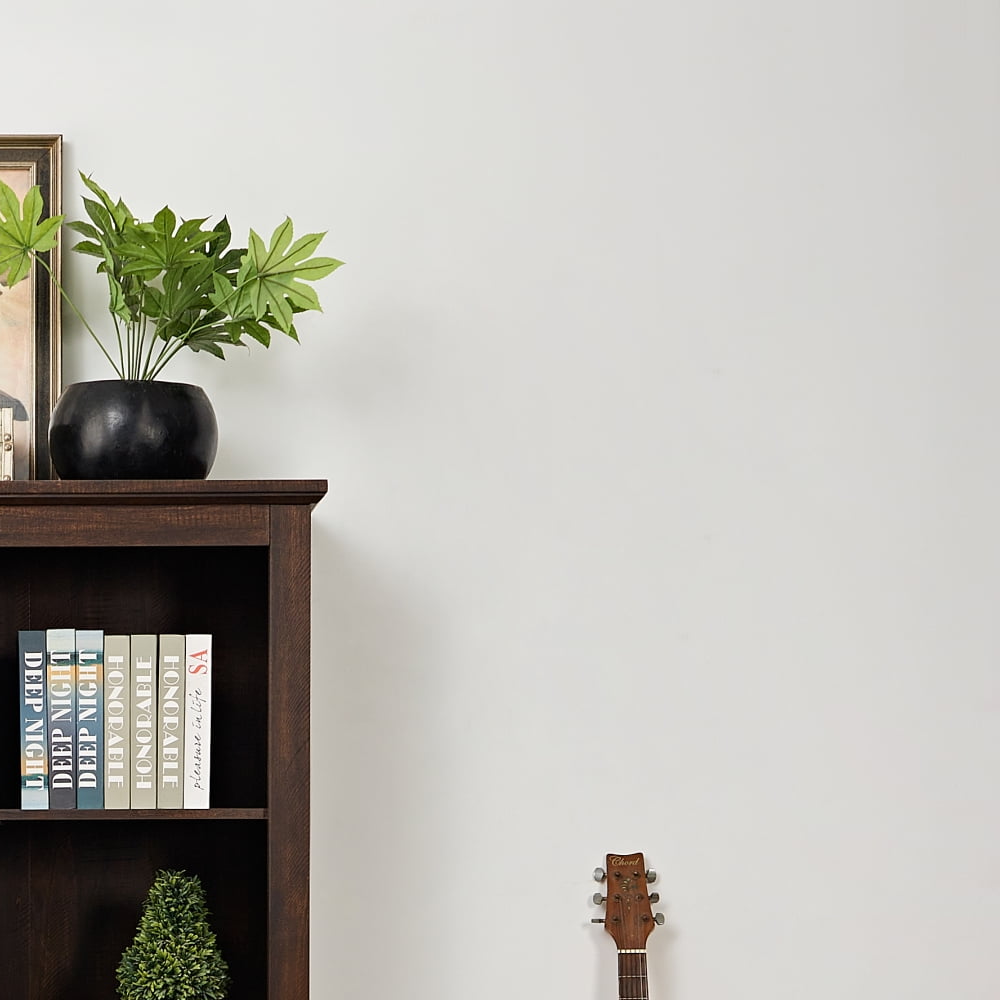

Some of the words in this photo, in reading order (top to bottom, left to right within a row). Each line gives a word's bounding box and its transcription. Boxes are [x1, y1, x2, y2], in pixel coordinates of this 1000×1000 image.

[24, 652, 43, 712] DEEP
[50, 650, 71, 722] NIGHT
[78, 649, 97, 721] NIGHT
[188, 649, 208, 675] SA
[25, 717, 44, 790] NIGHT
[107, 655, 124, 789] HONORABLE
[135, 655, 152, 789] HONORABLE
[162, 655, 179, 789] HONORABLE
[51, 728, 72, 789] DEEP
[78, 727, 97, 789] DEEP
[189, 732, 205, 790] pleasure
[609, 855, 640, 866] Chord
